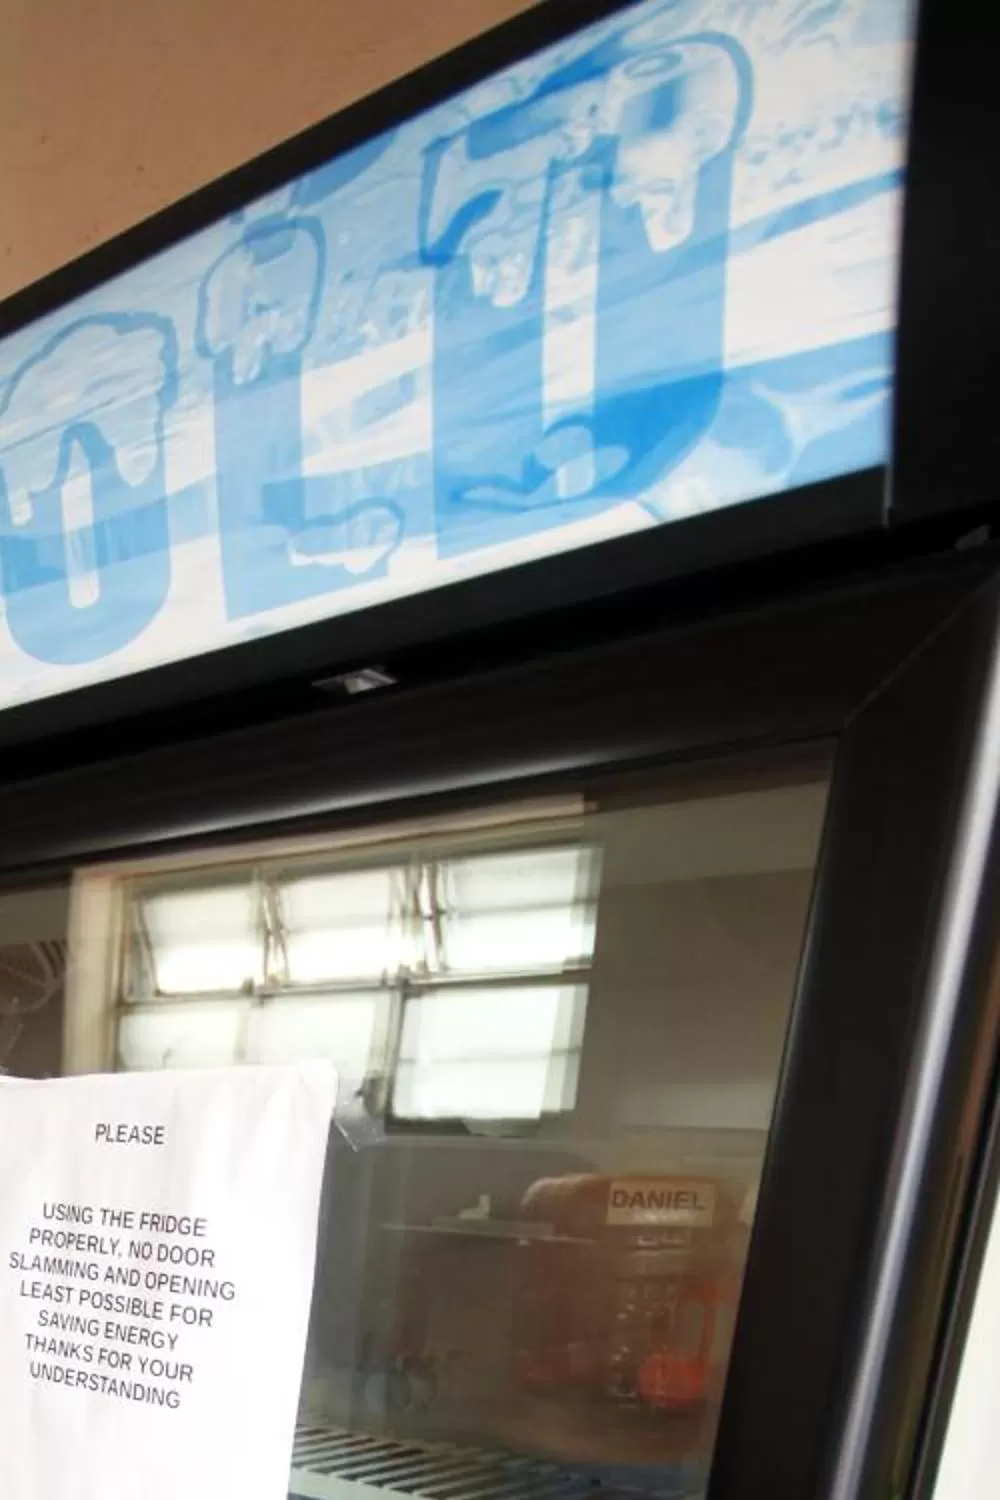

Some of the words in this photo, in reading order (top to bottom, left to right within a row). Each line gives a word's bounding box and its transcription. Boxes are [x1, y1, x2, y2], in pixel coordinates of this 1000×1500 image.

[95, 1122, 165, 1145] PLEASE
[43, 1202, 93, 1225] USING
[99, 1208, 134, 1230] THE
[139, 1213, 208, 1237] FRIDGE
[611, 1189, 707, 1211] DANIEL
[128, 1241, 153, 1260] NO
[157, 1244, 215, 1268] DOOR
[8, 1252, 99, 1281] SLAMMING
[104, 1265, 141, 1288] AND
[145, 1272, 236, 1301] OPENING
[20, 1280, 75, 1304] LEAST
[79, 1290, 163, 1321] POSSIBLE
[169, 1304, 214, 1328] FOR
[37, 1310, 100, 1337] SAVING
[104, 1322, 178, 1351] ENERGY
[25, 1334, 93, 1363] THANKS
[98, 1348, 132, 1371] FOR
[138, 1356, 194, 1382] YOUR
[29, 1362, 181, 1409] UNDERSTANDING
